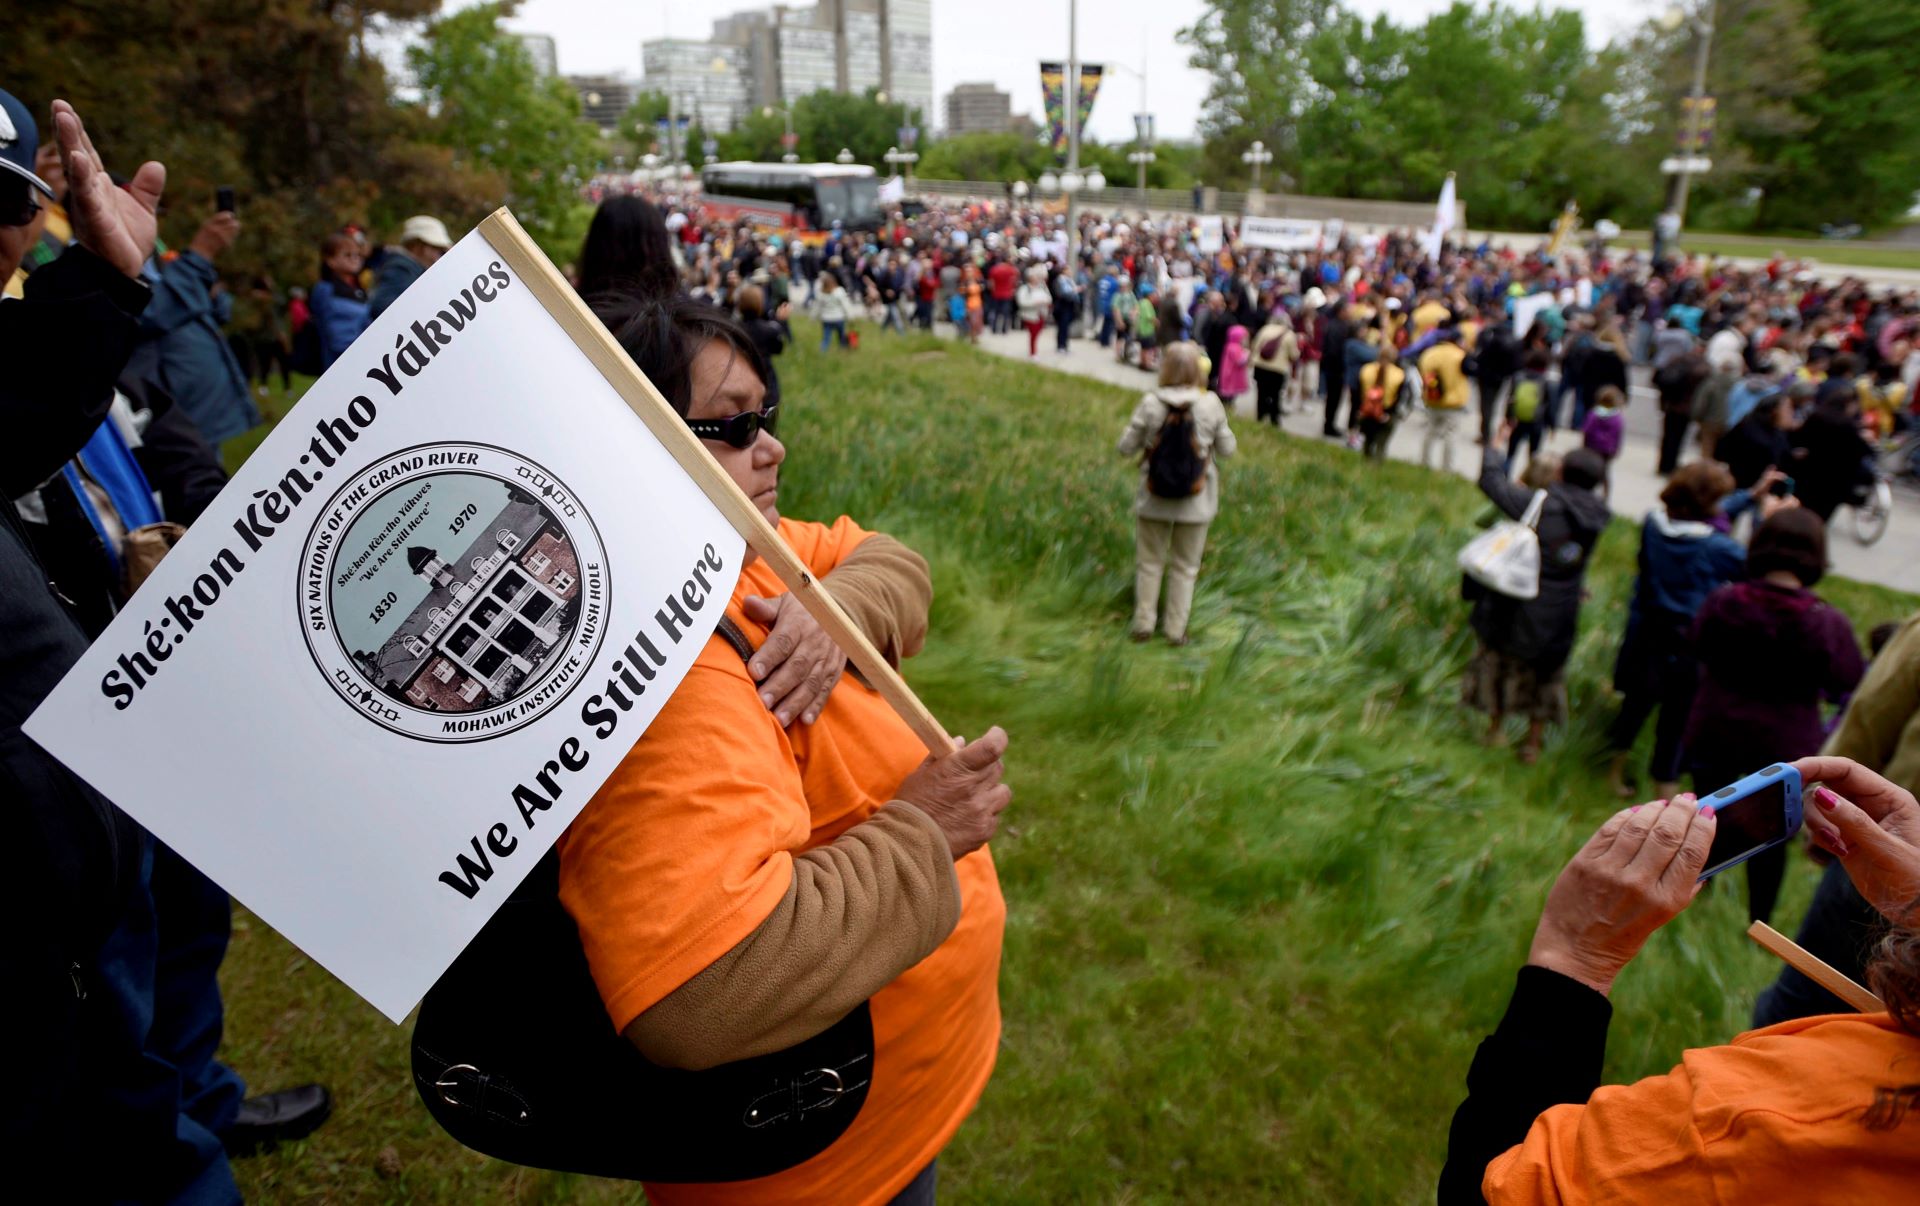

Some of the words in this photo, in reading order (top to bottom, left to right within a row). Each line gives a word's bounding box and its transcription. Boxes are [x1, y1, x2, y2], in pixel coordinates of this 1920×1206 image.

[369, 456, 424, 489] GRAND
[428, 452, 479, 467] RIVER
[101, 556, 245, 710] Shé:kon
[233, 396, 377, 553] Kèn:tho
[366, 261, 511, 396] Yákwes
[341, 482, 369, 511] THE
[327, 511, 346, 532] OF
[337, 551, 371, 587] Shé:kon
[368, 516, 401, 551] Kèn:tho
[398, 482, 432, 517] Yákwes
[449, 503, 477, 535] 1970
[377, 548, 393, 566] Are
[391, 528, 410, 550] Still
[309, 531, 333, 601] NATIONS
[587, 562, 601, 600] HOLE
[312, 603, 326, 631] SIX
[369, 592, 397, 624] 1830
[581, 602, 600, 648] MUSH
[519, 657, 581, 715] INSTITUTE
[438, 823, 518, 899] We
[511, 737, 590, 830] Are
[581, 630, 667, 740] Still
[654, 543, 723, 645] Here
[442, 706, 518, 733] MOHAWK
